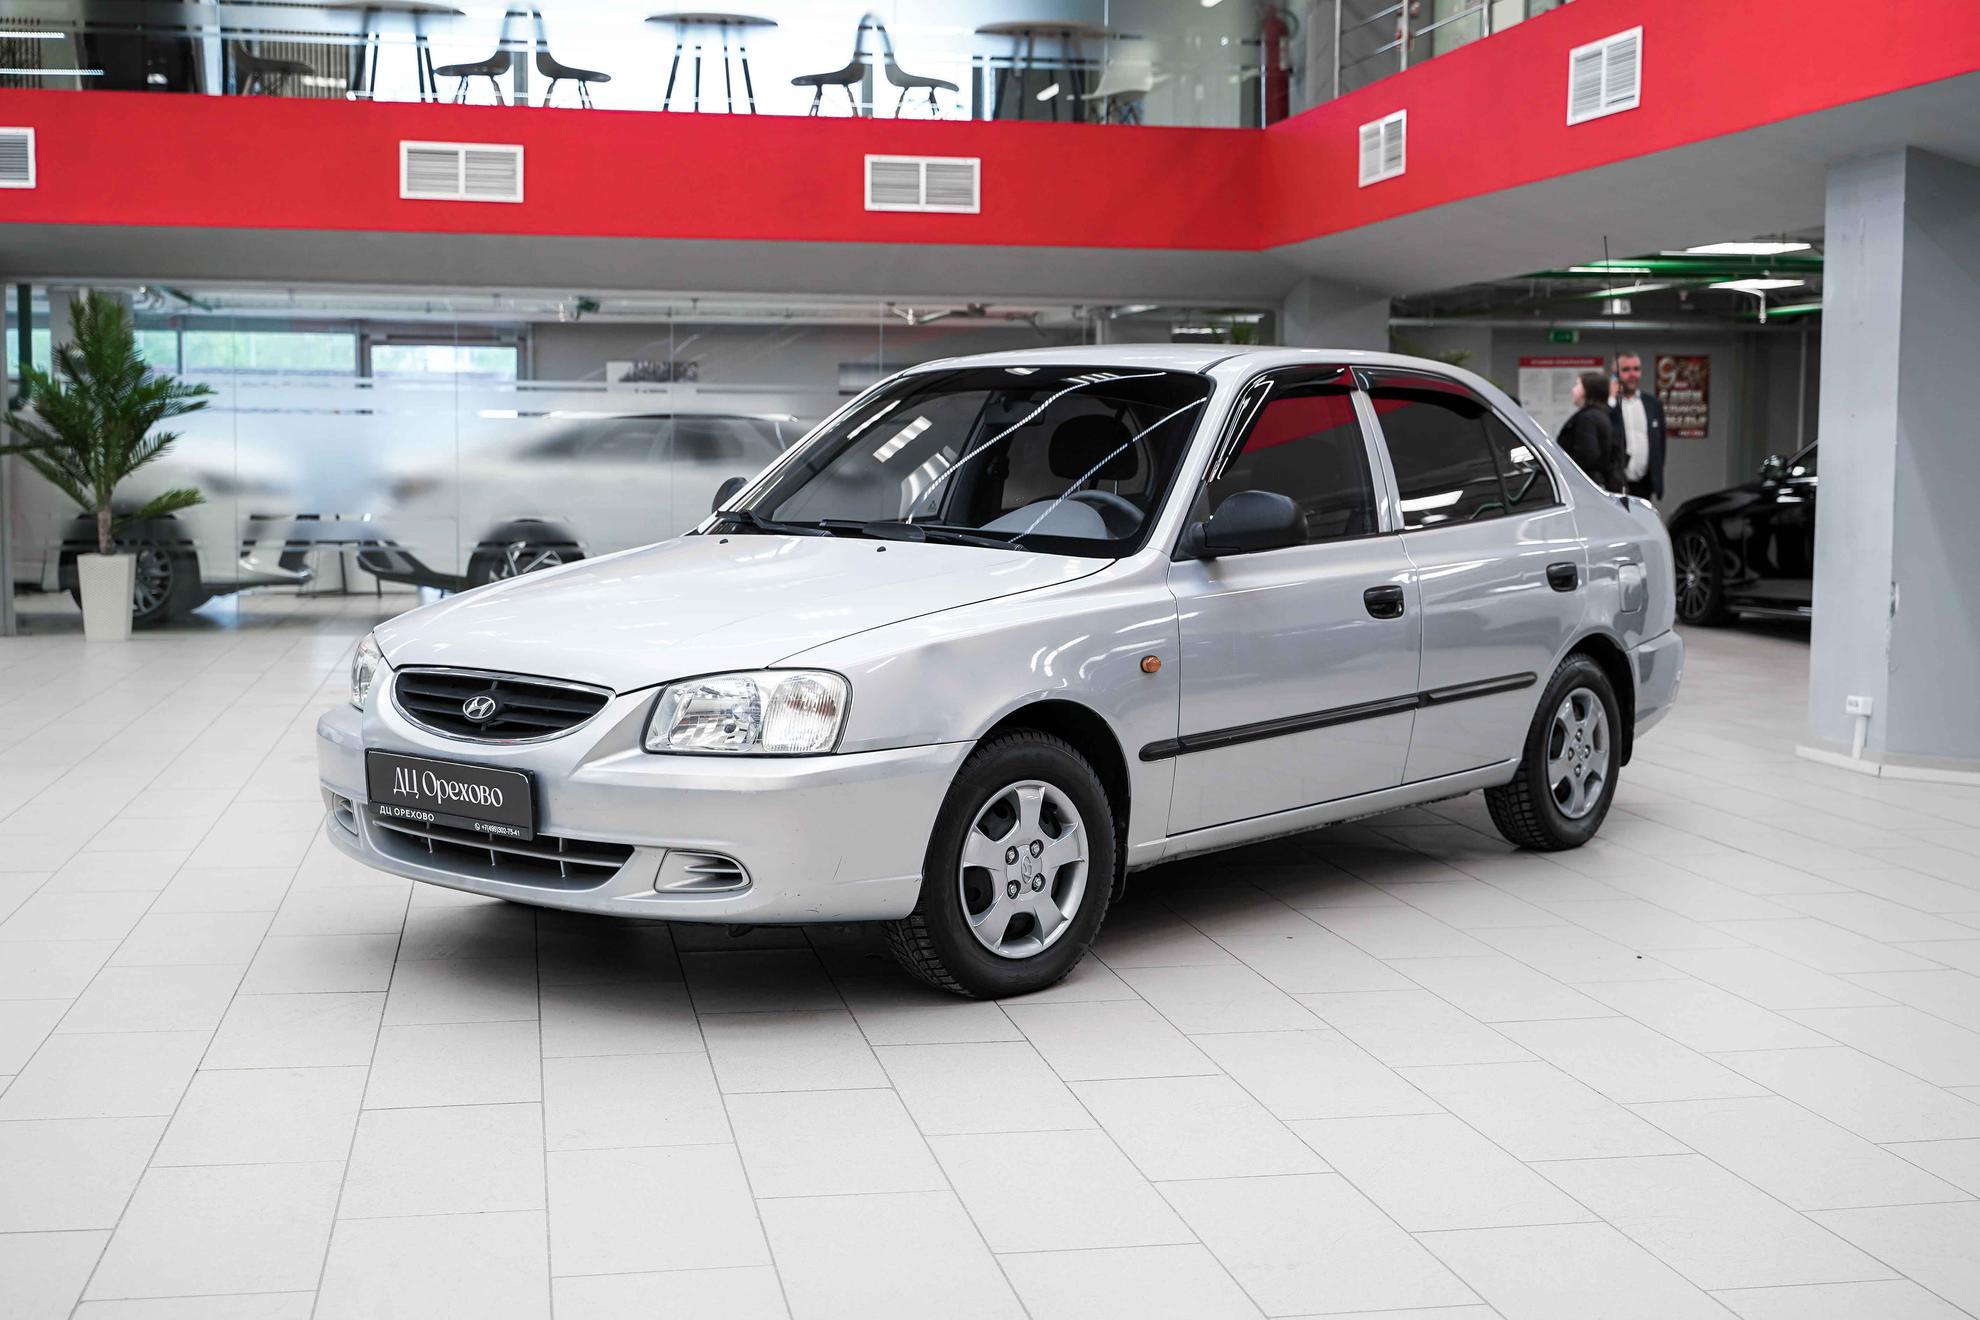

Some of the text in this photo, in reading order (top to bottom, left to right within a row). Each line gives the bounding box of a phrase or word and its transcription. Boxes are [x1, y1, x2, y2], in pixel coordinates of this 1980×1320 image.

[393, 767, 503, 807] ДЦ Орехово
[379, 805, 435, 822] ДЦ ОРЕХОВО
